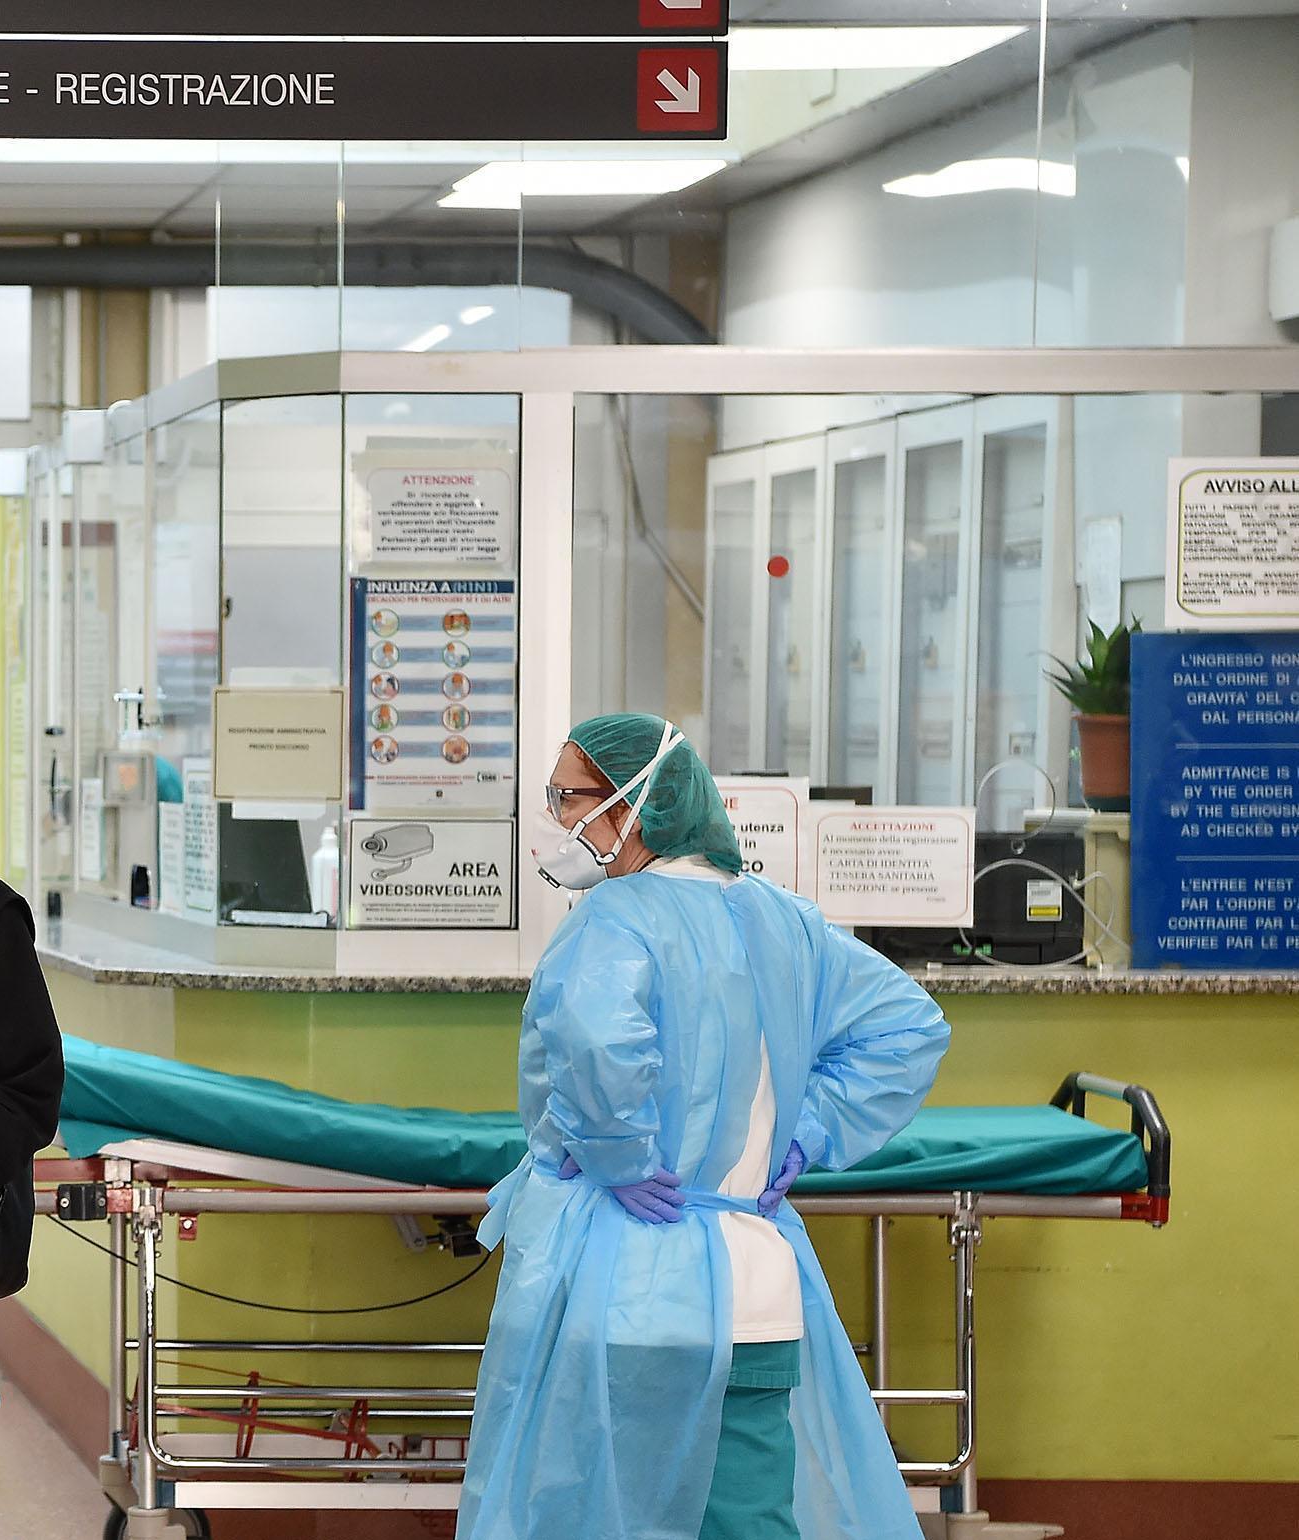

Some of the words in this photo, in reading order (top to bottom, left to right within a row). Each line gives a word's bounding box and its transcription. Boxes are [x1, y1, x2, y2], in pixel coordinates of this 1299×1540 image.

[55, 73, 335, 106] REGISTRAZIONE
[402, 475, 475, 486] ATTENZIONE
[1204, 479, 1265, 494] AVVISO
[454, 491, 470, 499] che
[367, 580, 436, 593] INFLUENZA
[439, 580, 451, 593] A
[1181, 653, 1264, 667] L'INGRESSO
[1173, 672, 1212, 686] DALL'
[1216, 672, 1269, 686] ORDINE
[1276, 672, 1290, 686] DI
[1187, 691, 1249, 706] GRAVITA'
[1256, 691, 1284, 705] DEL
[1202, 710, 1229, 724] DAL
[1182, 766, 1269, 780] ADMITTANCE
[1277, 766, 1290, 780] IS
[1184, 785, 1202, 799] BY
[1211, 785, 1237, 799] THE
[1244, 785, 1293, 799] ORDER
[1171, 804, 1188, 818] BY
[1196, 804, 1223, 818] THE
[741, 823, 784, 832] utenza
[851, 822, 936, 832] ACCETTAZIONE
[1180, 823, 1200, 837] AS
[1207, 823, 1273, 837] CHECKED
[745, 839, 757, 848] in
[823, 834, 834, 843] Al
[836, 836, 877, 844] momento
[879, 835, 901, 844] della
[902, 836, 958, 846] registrazione
[449, 862, 499, 877] AREA
[866, 859, 877, 868] DI
[878, 872, 935, 881] SANITARIA
[360, 883, 503, 897] VIDEOSORVEGLIATA
[902, 885, 939, 895] presente
[1181, 878, 1247, 892] L'ENTREE
[1254, 878, 1293, 892] N'EST
[1181, 897, 1208, 911] PAR
[1216, 897, 1276, 911] L'ORDRE
[1168, 917, 1248, 931] CONTRAIRE
[1256, 917, 1283, 931] PAR
[1158, 936, 1219, 950] VERIFIEE
[1227, 936, 1254, 950] PAR
[1261, 936, 1278, 950] LE
